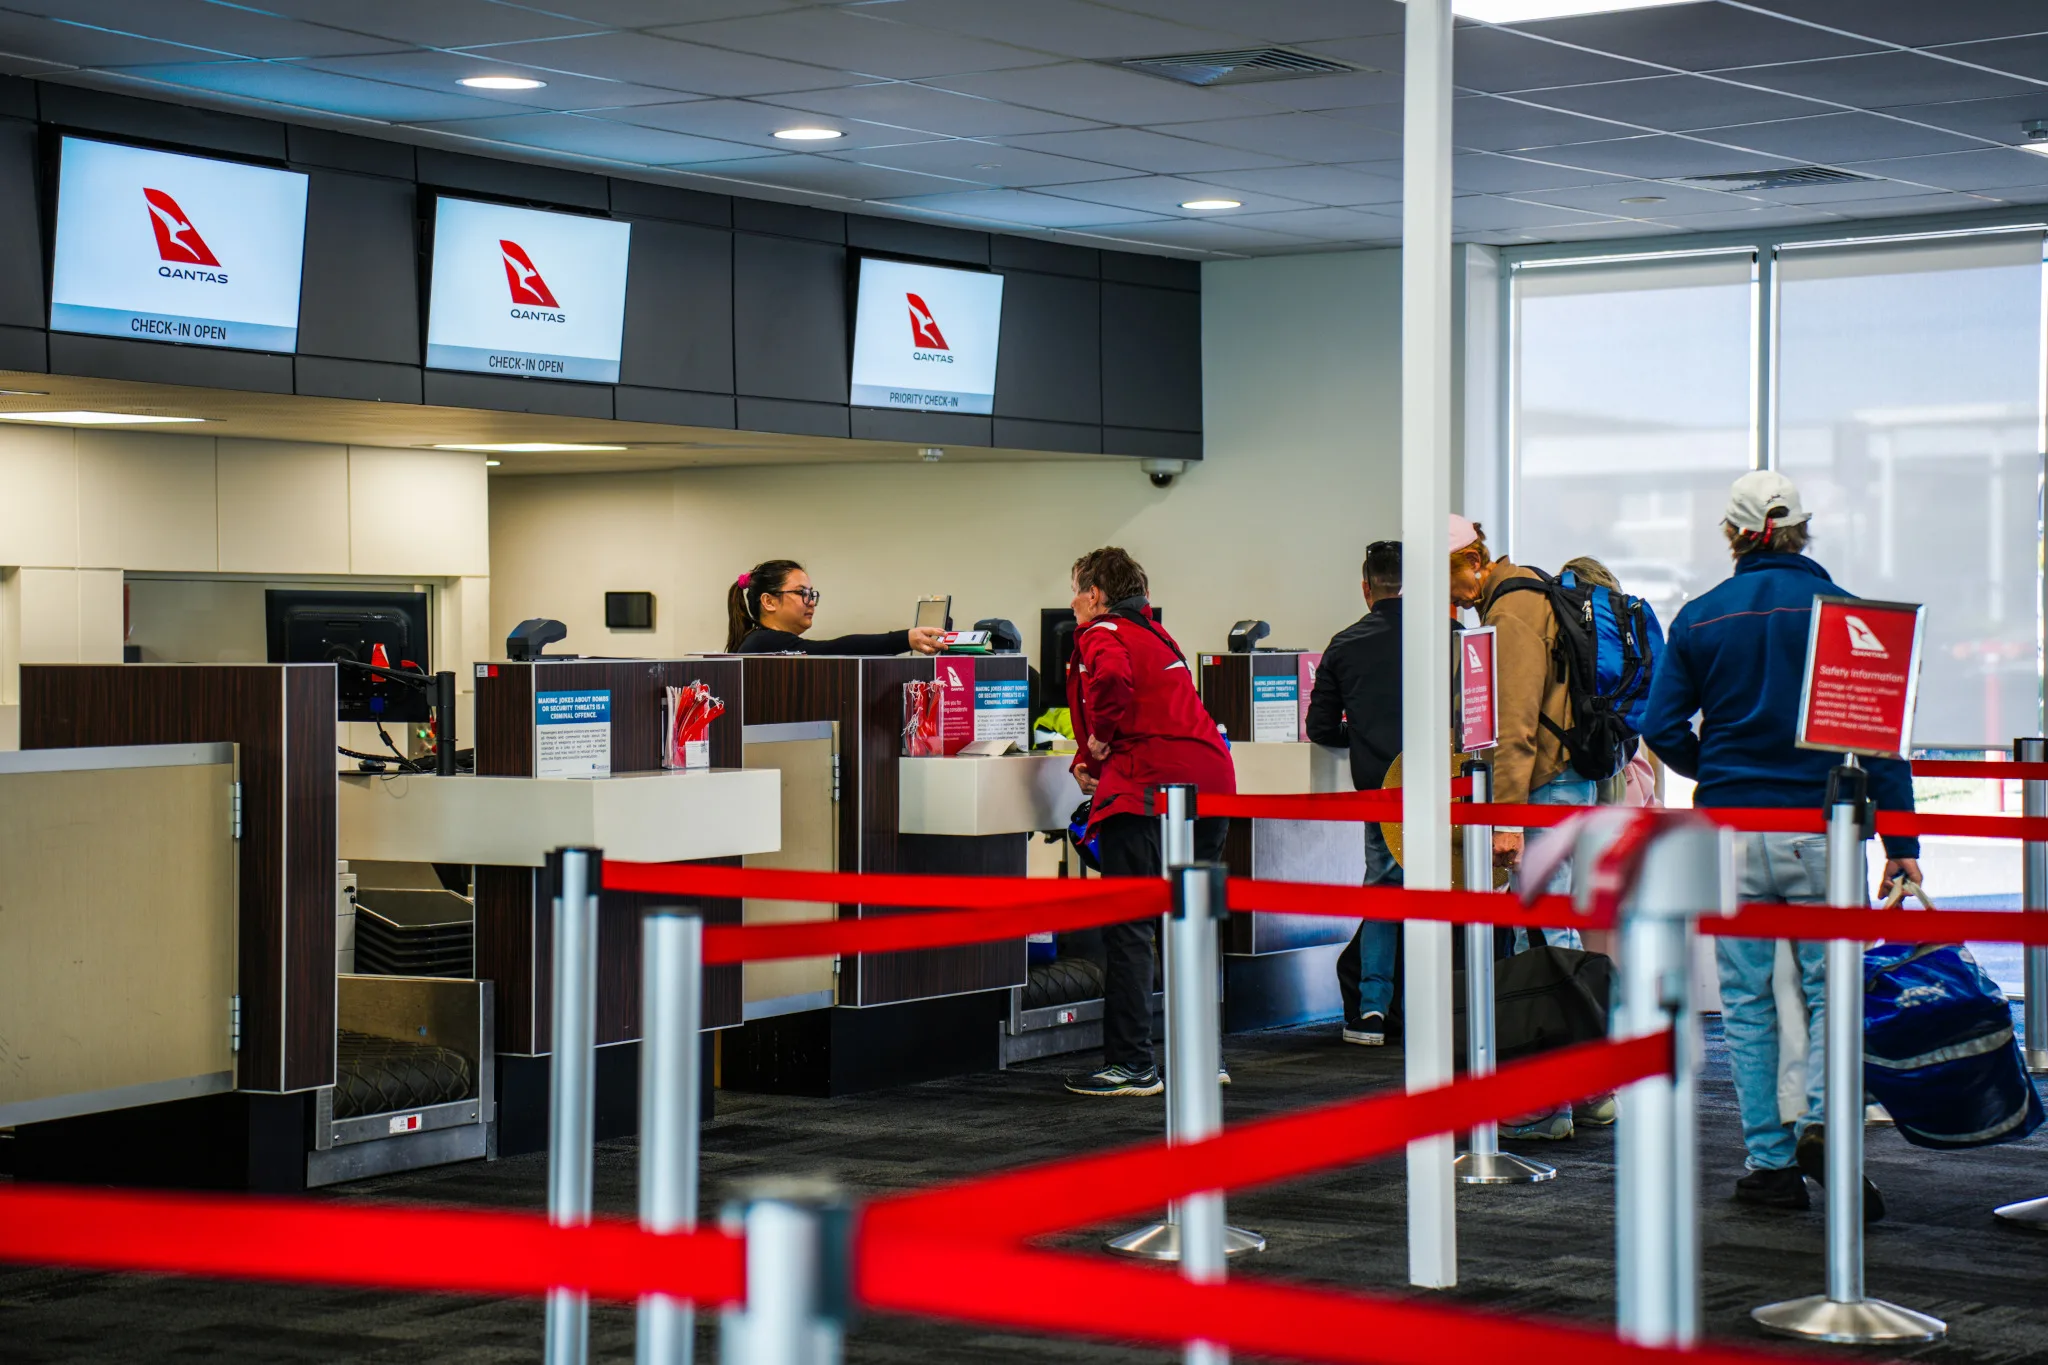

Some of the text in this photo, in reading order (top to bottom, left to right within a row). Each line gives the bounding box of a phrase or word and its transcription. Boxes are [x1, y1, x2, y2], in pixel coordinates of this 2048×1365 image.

[158, 266, 228, 284] QANTAS
[510, 308, 566, 323] QANTAS
[131, 318, 226, 340] CHECK-IN OPEN
[488, 356, 564, 373] CHECK-IN OPEN
[912, 352, 954, 364] QANTAS
[889, 392, 958, 407] PRIORITY CHECK-IN
[1819, 664, 1849, 679] Safety
